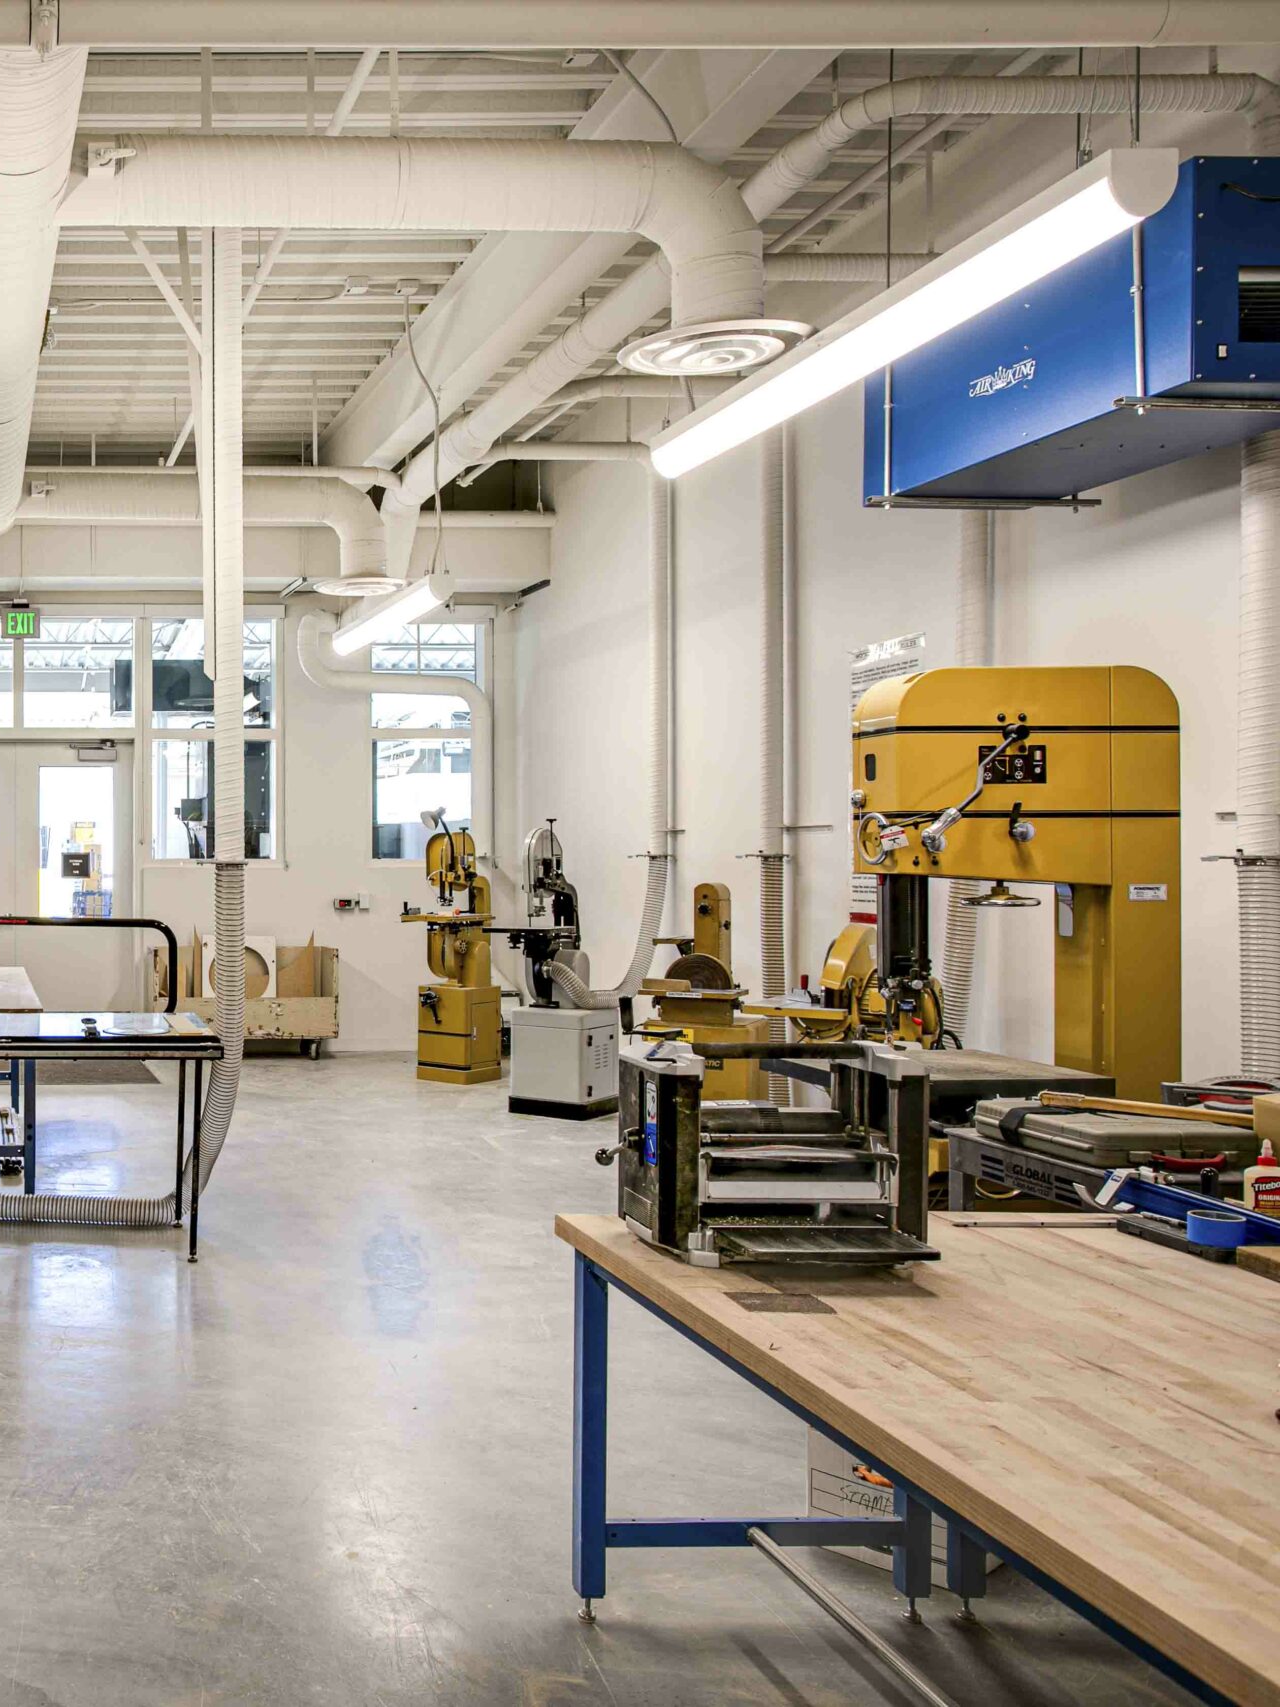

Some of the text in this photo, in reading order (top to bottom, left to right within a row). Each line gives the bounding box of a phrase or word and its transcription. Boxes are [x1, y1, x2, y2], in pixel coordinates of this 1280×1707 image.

[969, 360, 1037, 397] AIR KING
[7, 612, 36, 635] EXIT
[1012, 1164, 1053, 1185] GLOBAL
